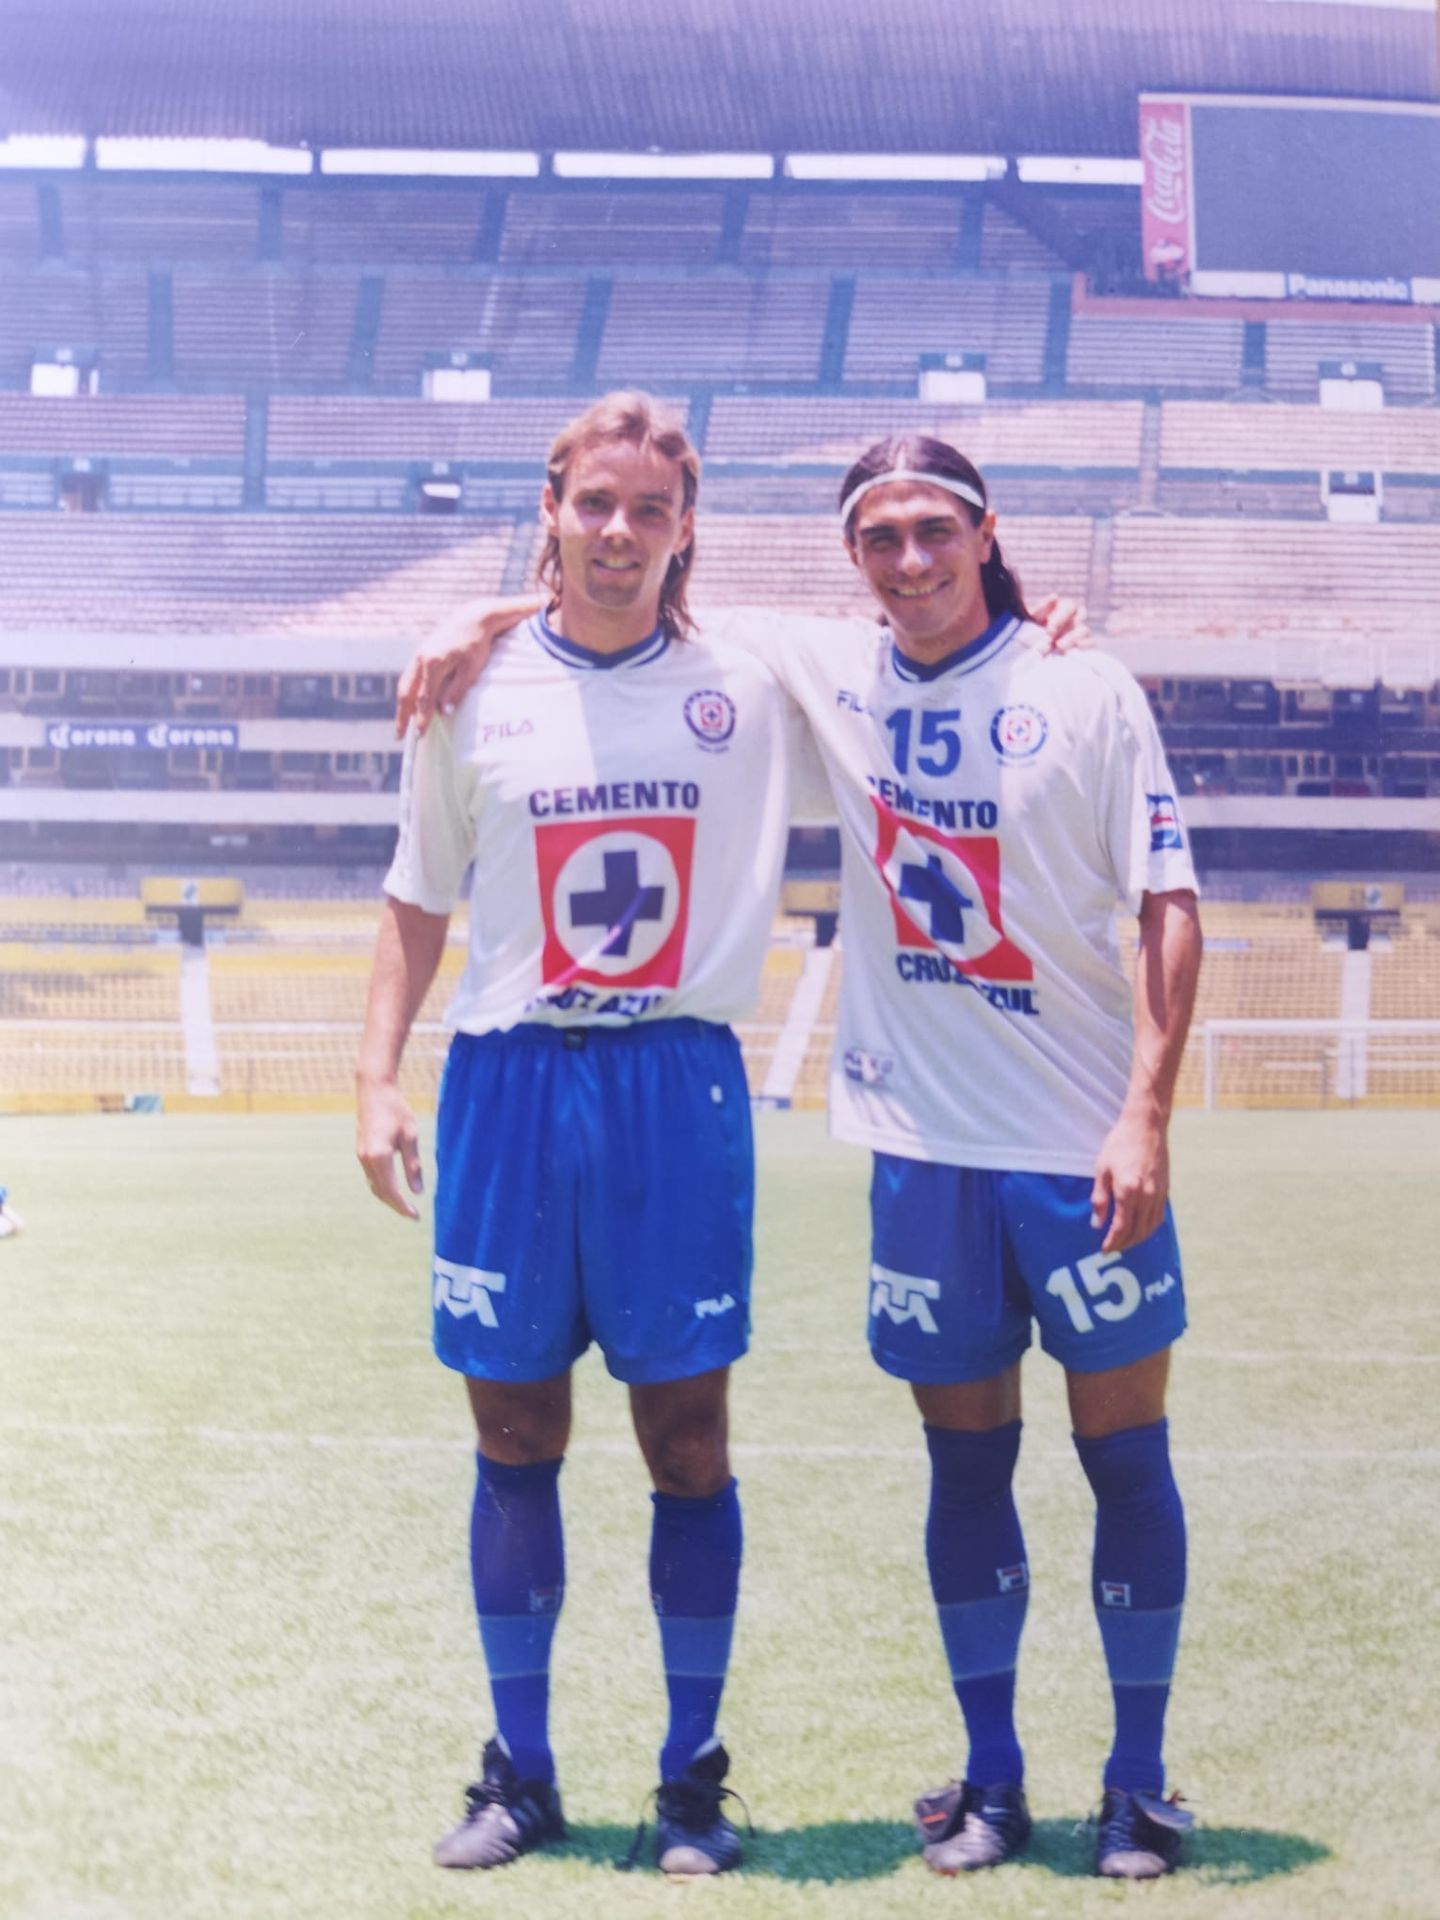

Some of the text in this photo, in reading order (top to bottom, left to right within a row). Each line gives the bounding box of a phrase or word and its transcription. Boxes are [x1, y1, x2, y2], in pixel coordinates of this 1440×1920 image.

[482, 718, 535, 744] FILA
[885, 709, 962, 777] 15
[528, 780, 700, 817] CEMENTO
[1045, 1250, 1142, 1334] 15
